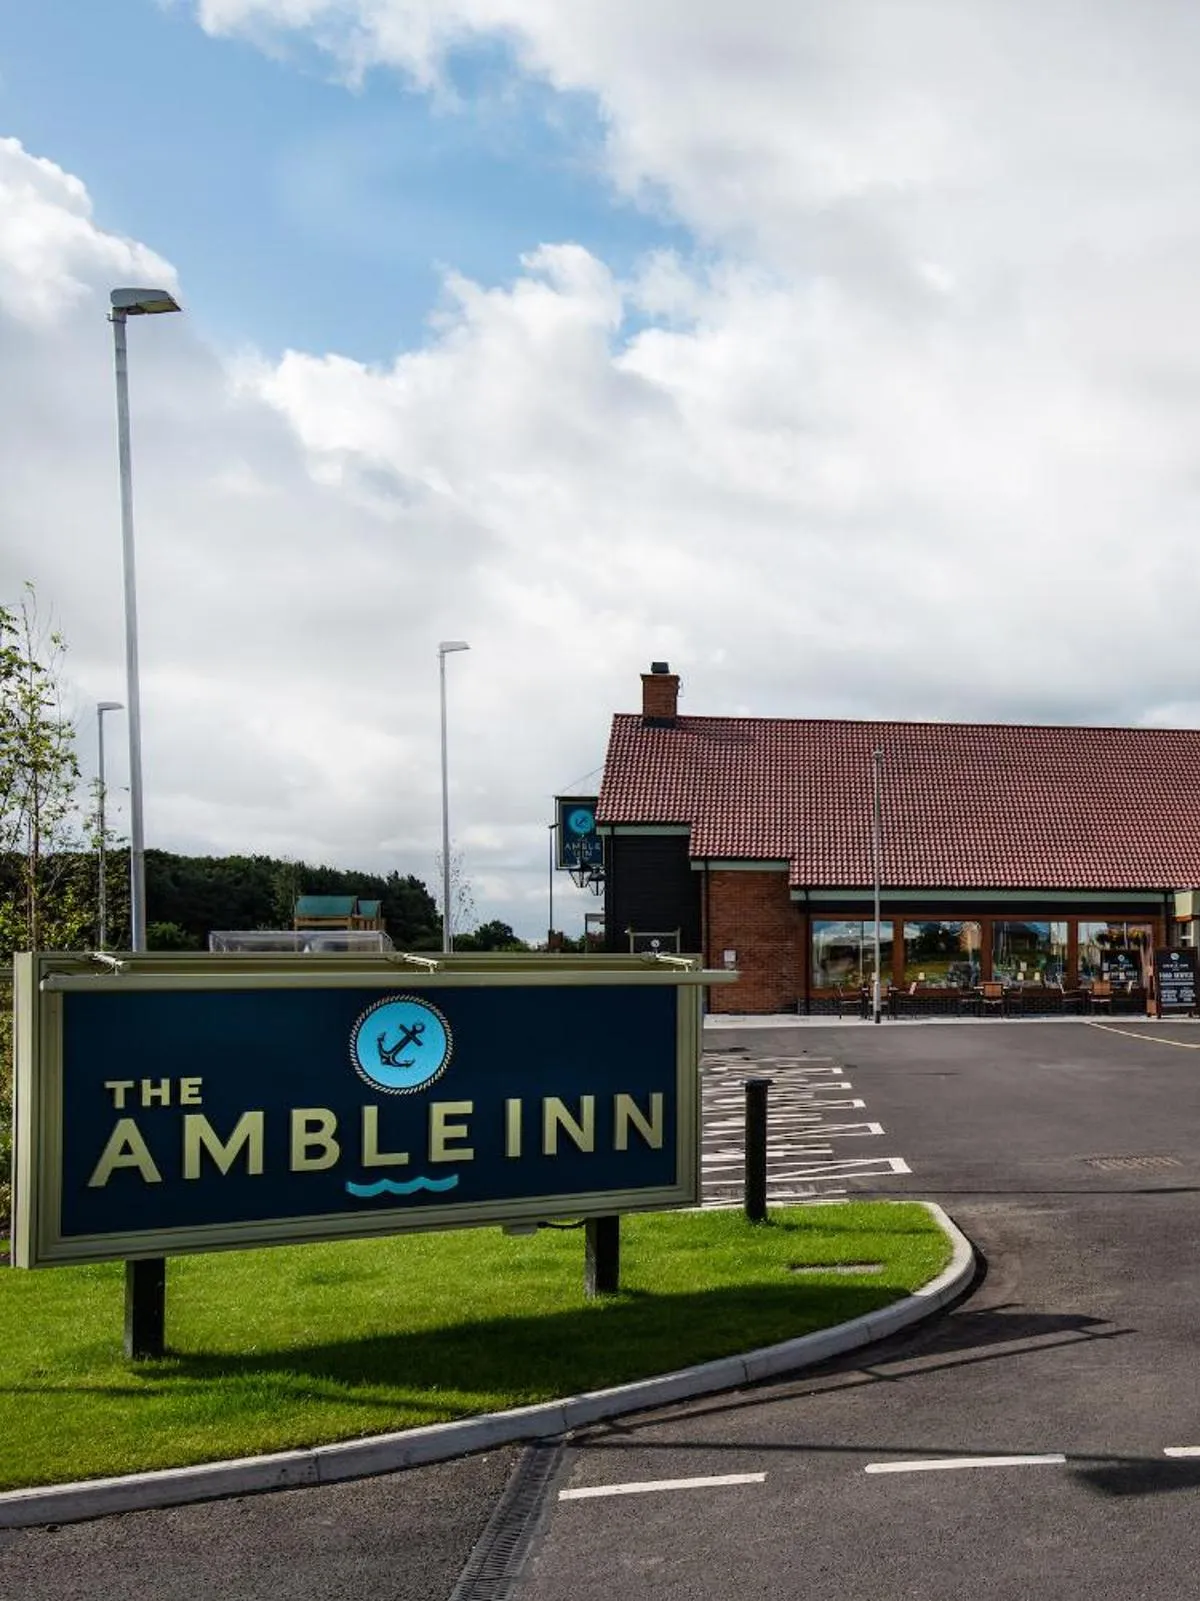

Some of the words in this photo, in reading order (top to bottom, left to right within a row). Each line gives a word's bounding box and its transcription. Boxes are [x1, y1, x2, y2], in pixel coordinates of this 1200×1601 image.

[104, 1077, 203, 1109] THE
[88, 1100, 475, 1187] AMBLE
[504, 1093, 664, 1158] INN
